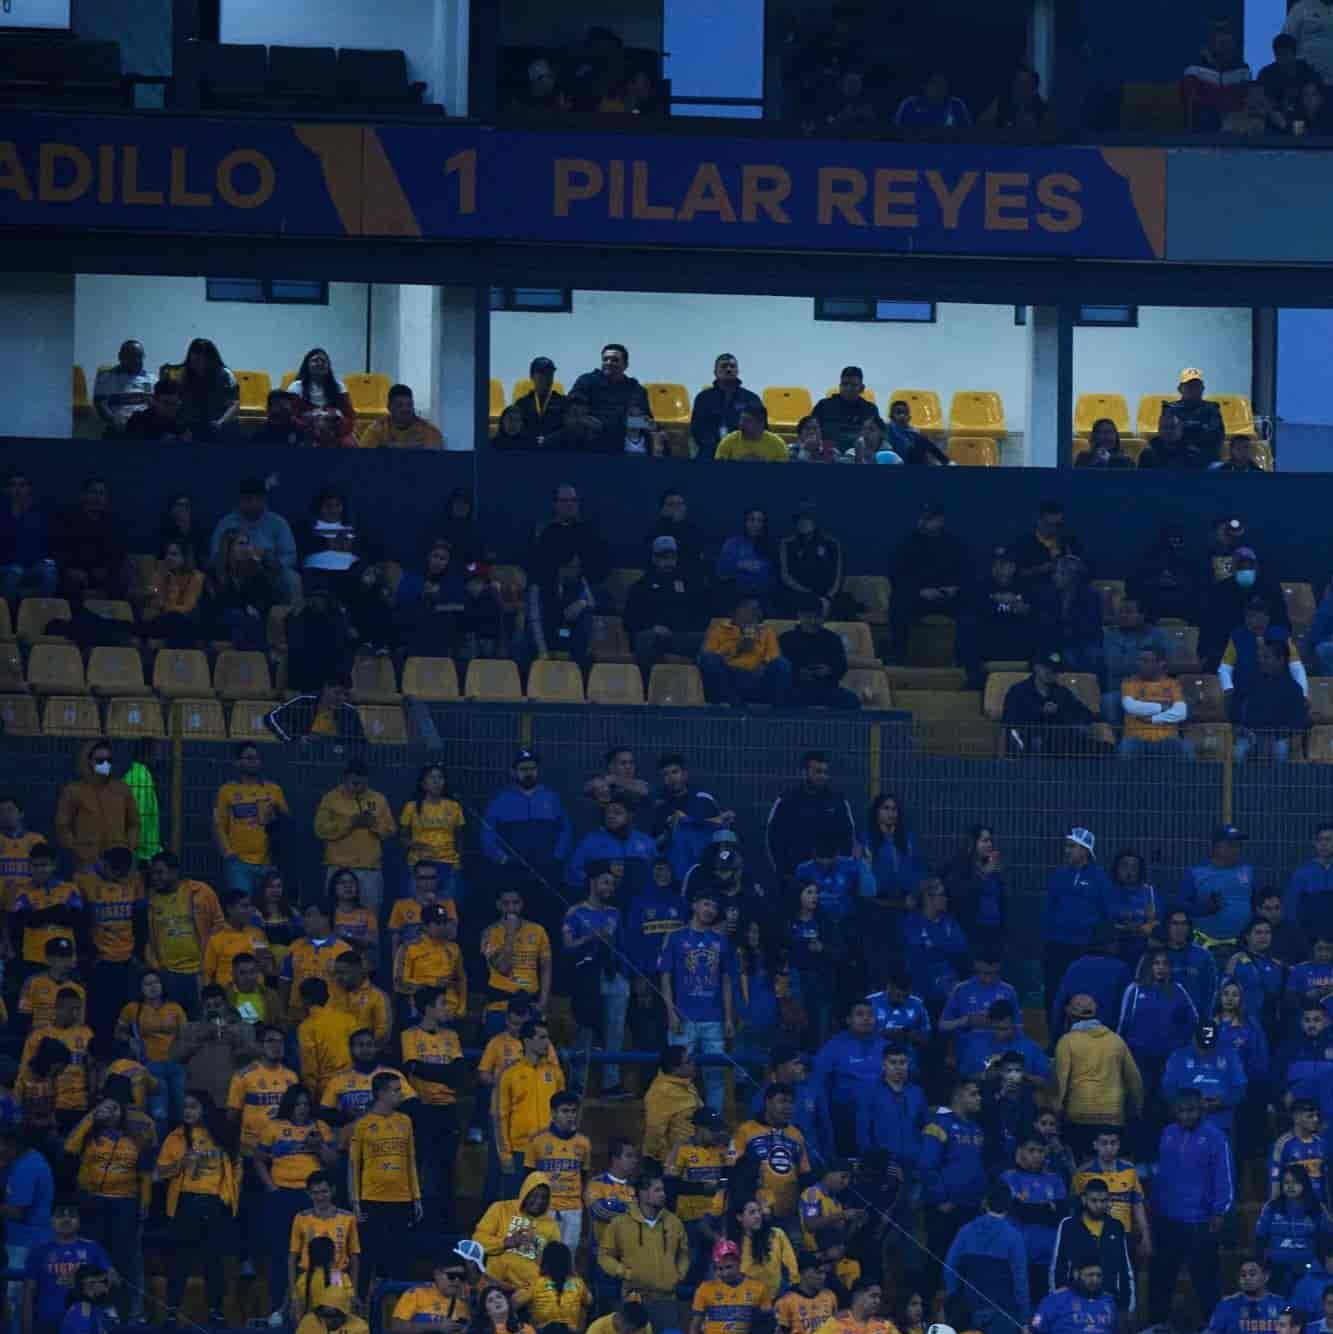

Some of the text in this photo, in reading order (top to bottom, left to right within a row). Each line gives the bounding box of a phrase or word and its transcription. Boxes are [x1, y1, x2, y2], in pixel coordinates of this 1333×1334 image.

[0, 141, 276, 209] ADILLO
[442, 148, 1085, 233] 1 PILAR REYES
